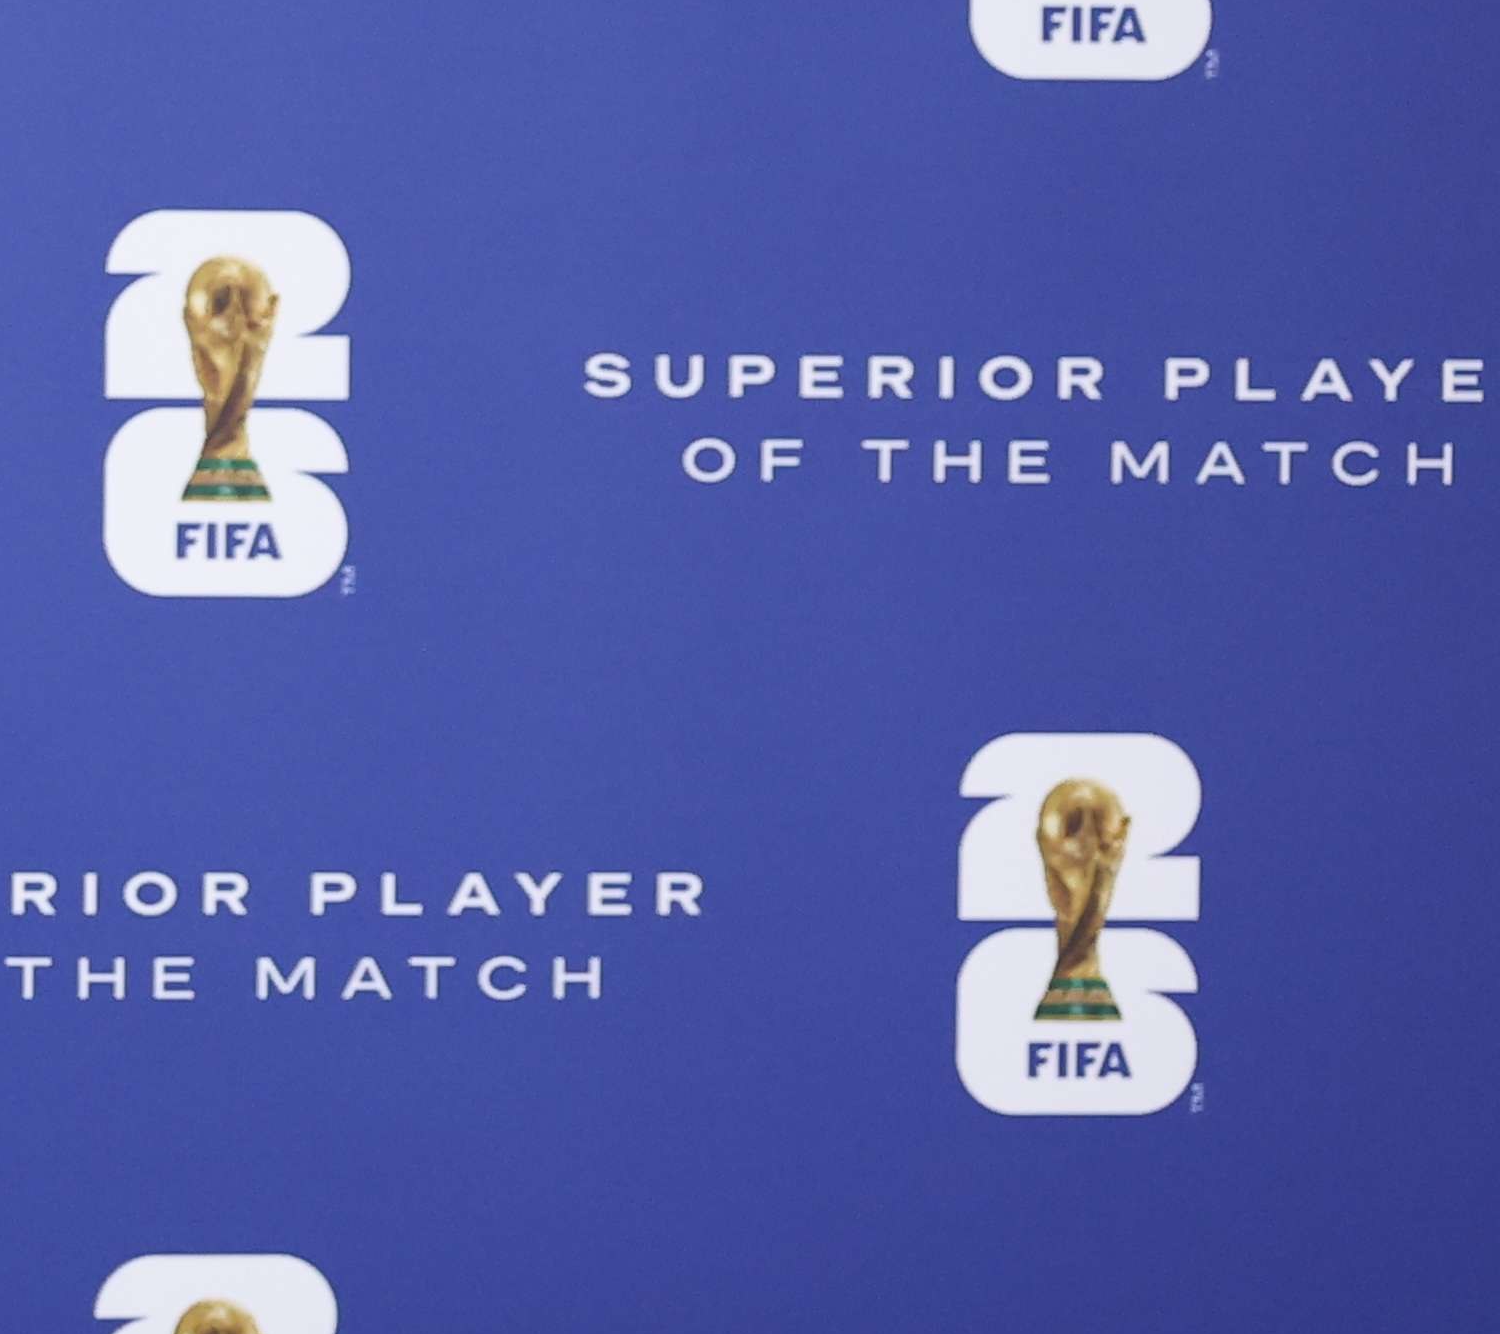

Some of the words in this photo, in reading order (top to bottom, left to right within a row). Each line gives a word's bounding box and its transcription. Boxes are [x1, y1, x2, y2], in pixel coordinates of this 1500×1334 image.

[1042, 6, 1145, 43] FIFA
[583, 352, 1104, 401] SUPERIOR
[1165, 358, 1484, 402] PLAYE
[682, 437, 804, 483] OF
[860, 439, 1051, 484] THE
[1110, 440, 1453, 486] MATCH
[176, 522, 280, 560] FIFA
[309, 871, 703, 917] PLAYER
[3, 956, 196, 1001] THE
[255, 955, 601, 1001] MATCH
[1028, 1042, 1131, 1078] FIFA
